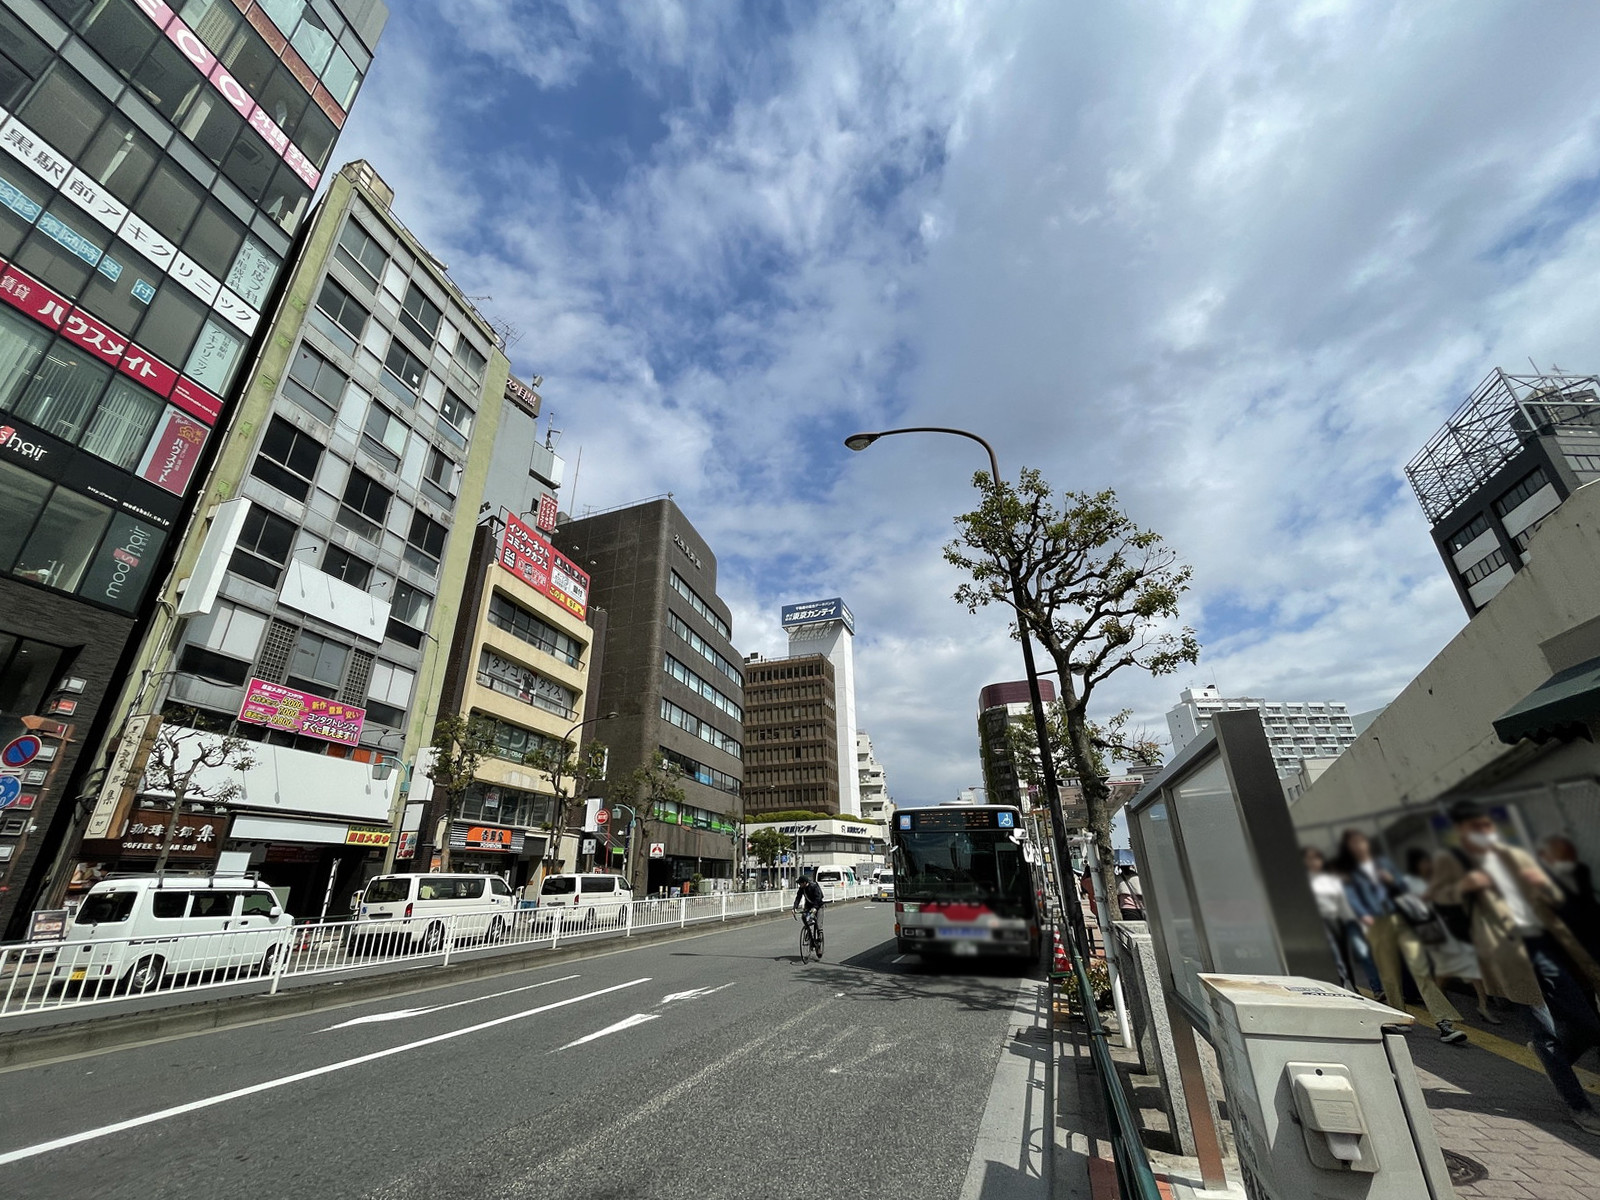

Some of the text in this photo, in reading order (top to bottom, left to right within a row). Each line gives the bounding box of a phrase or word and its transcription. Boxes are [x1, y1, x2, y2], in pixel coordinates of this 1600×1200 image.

[4, 128, 252, 321] 黒駅前アキクリニック
[37, 300, 158, 378] ハウスメイト
[192, 330, 222, 376] アキクリニック
[6, 432, 49, 459] hair
[158, 438, 184, 483] ハウスメイト
[119, 525, 147, 558] hair
[506, 533, 548, 570] コミックカフェ
[509, 523, 550, 558] インターネット
[122, 842, 153, 850] COFFEE
